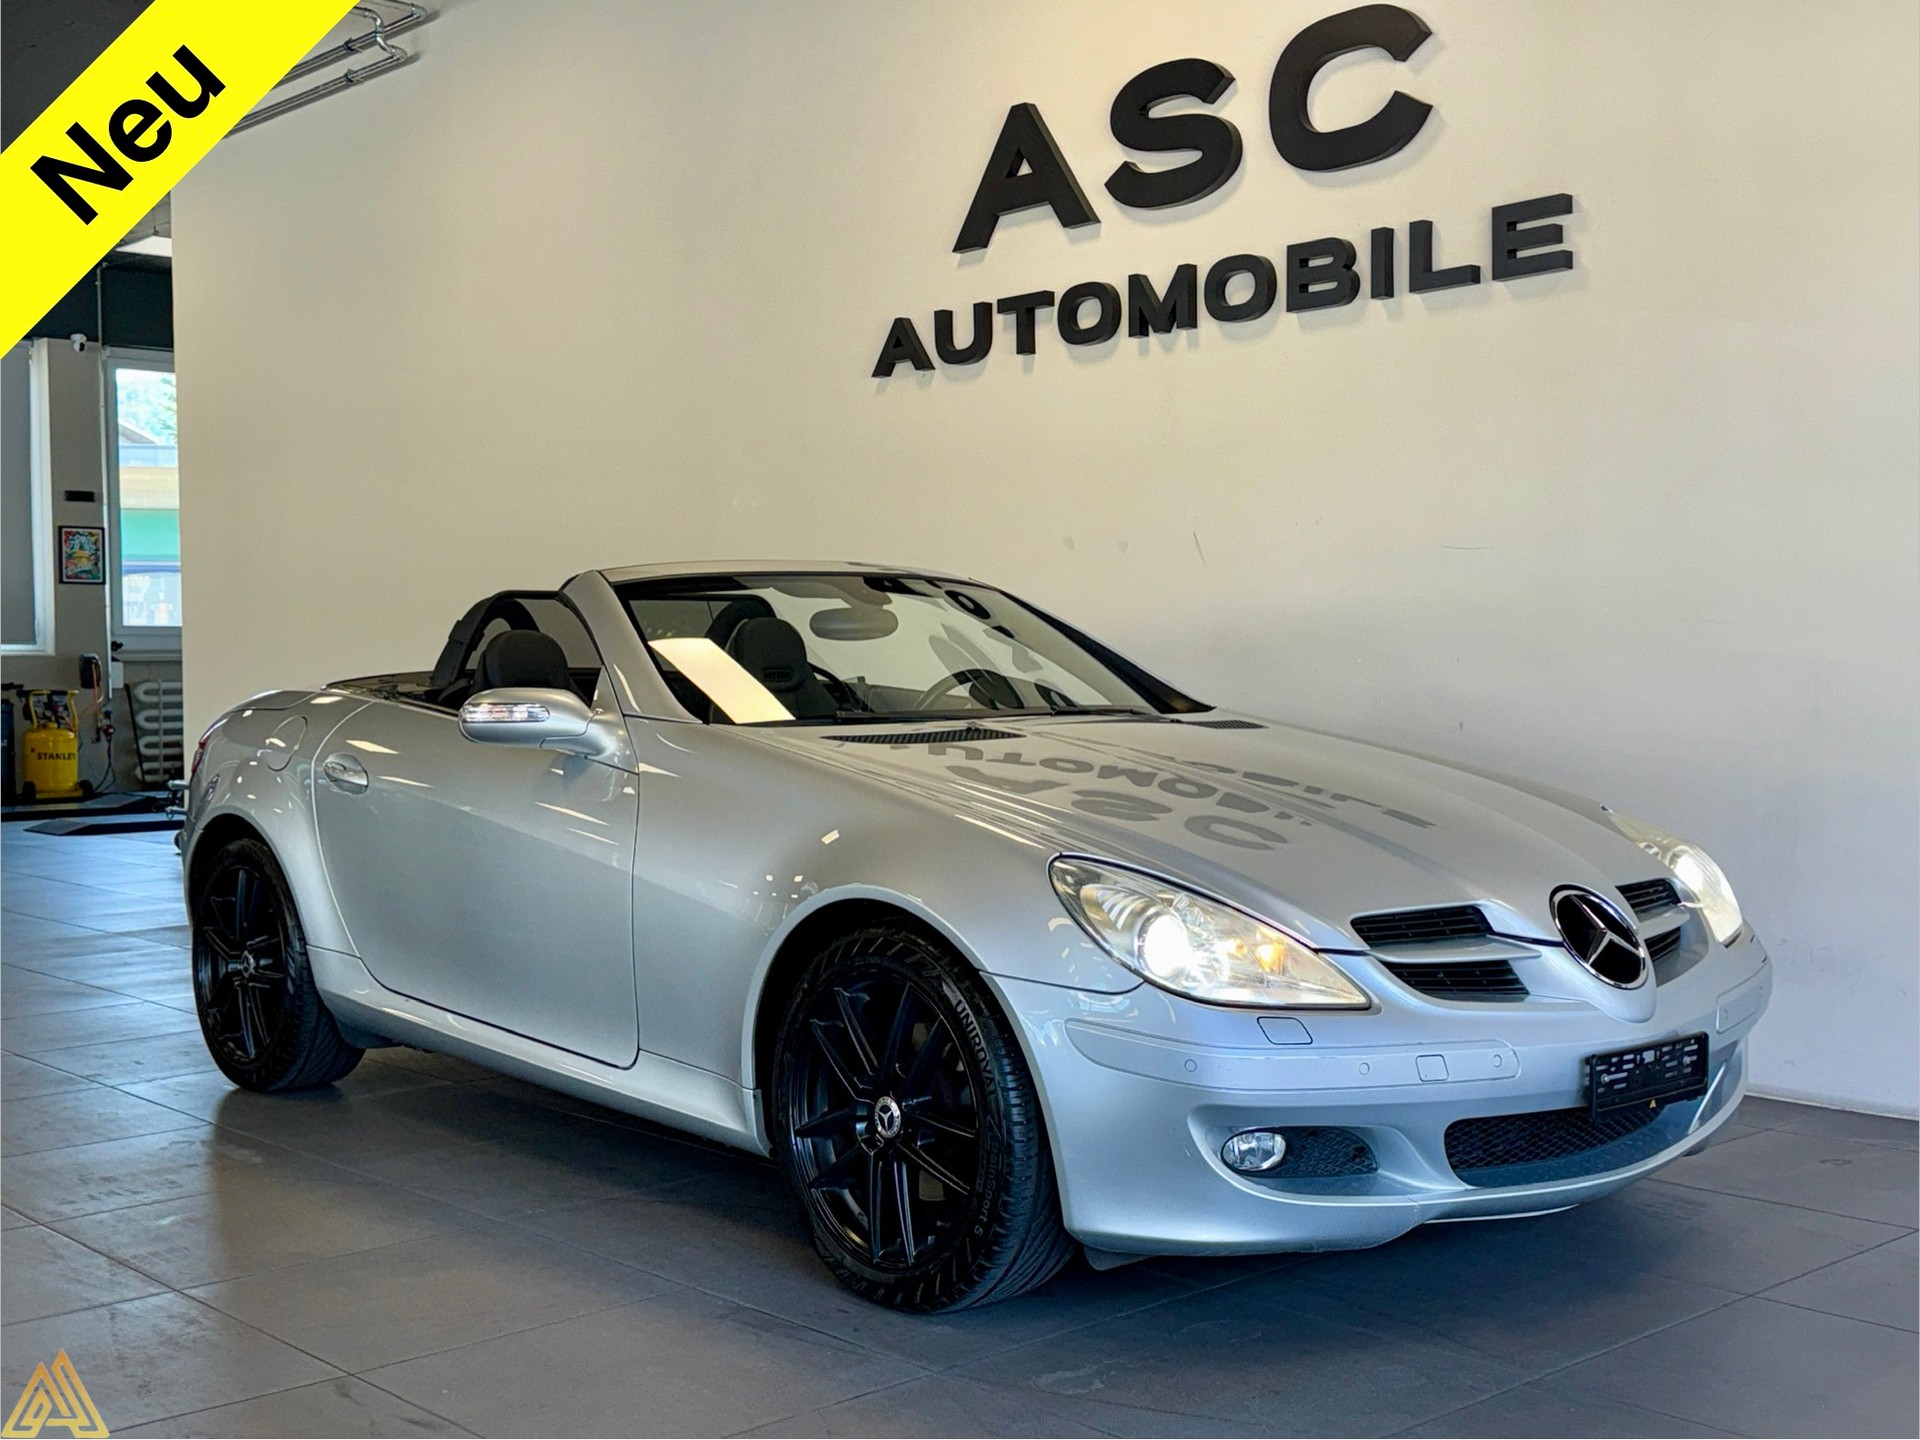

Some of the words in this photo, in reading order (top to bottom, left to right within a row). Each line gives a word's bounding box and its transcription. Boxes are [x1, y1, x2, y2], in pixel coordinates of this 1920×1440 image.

[952, 3, 1433, 253] ASC
[871, 193, 1573, 378] AUTOMOBILE
[954, 999, 997, 1096] UNIROYAL
